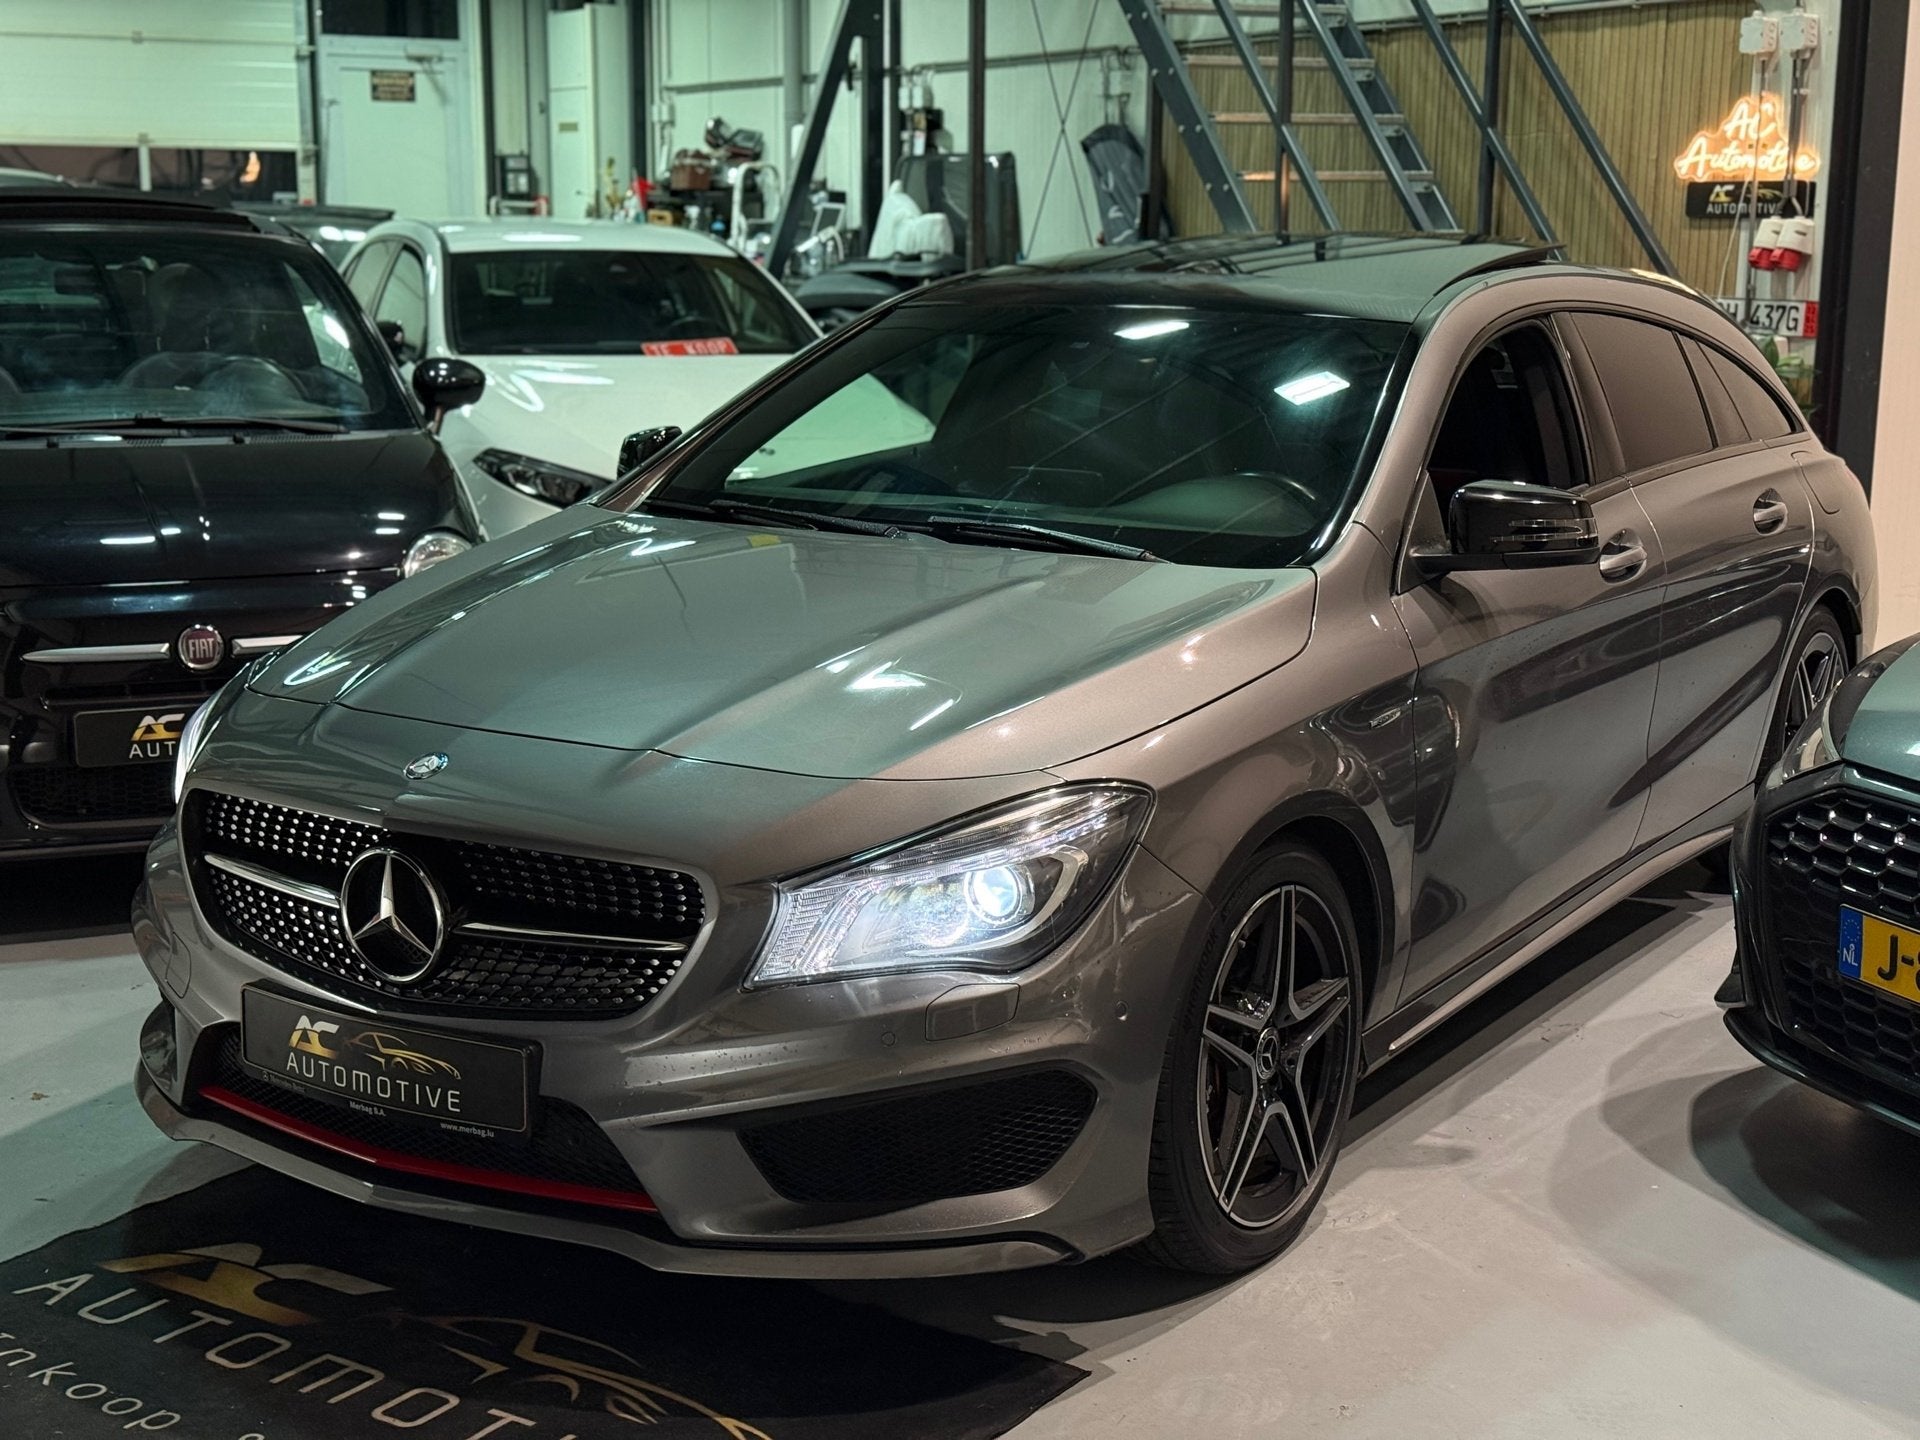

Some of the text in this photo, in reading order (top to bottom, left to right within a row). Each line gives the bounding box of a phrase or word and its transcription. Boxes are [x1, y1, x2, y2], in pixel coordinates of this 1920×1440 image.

[1677, 136, 1816, 177] Automotie
[1706, 203, 1783, 215] AUTOMTIV
[188, 638, 215, 659] FIAT
[1842, 947, 1858, 966] NL
[1877, 934, 1920, 991] J-
[286, 1052, 461, 1113] AUTOMOTIVE
